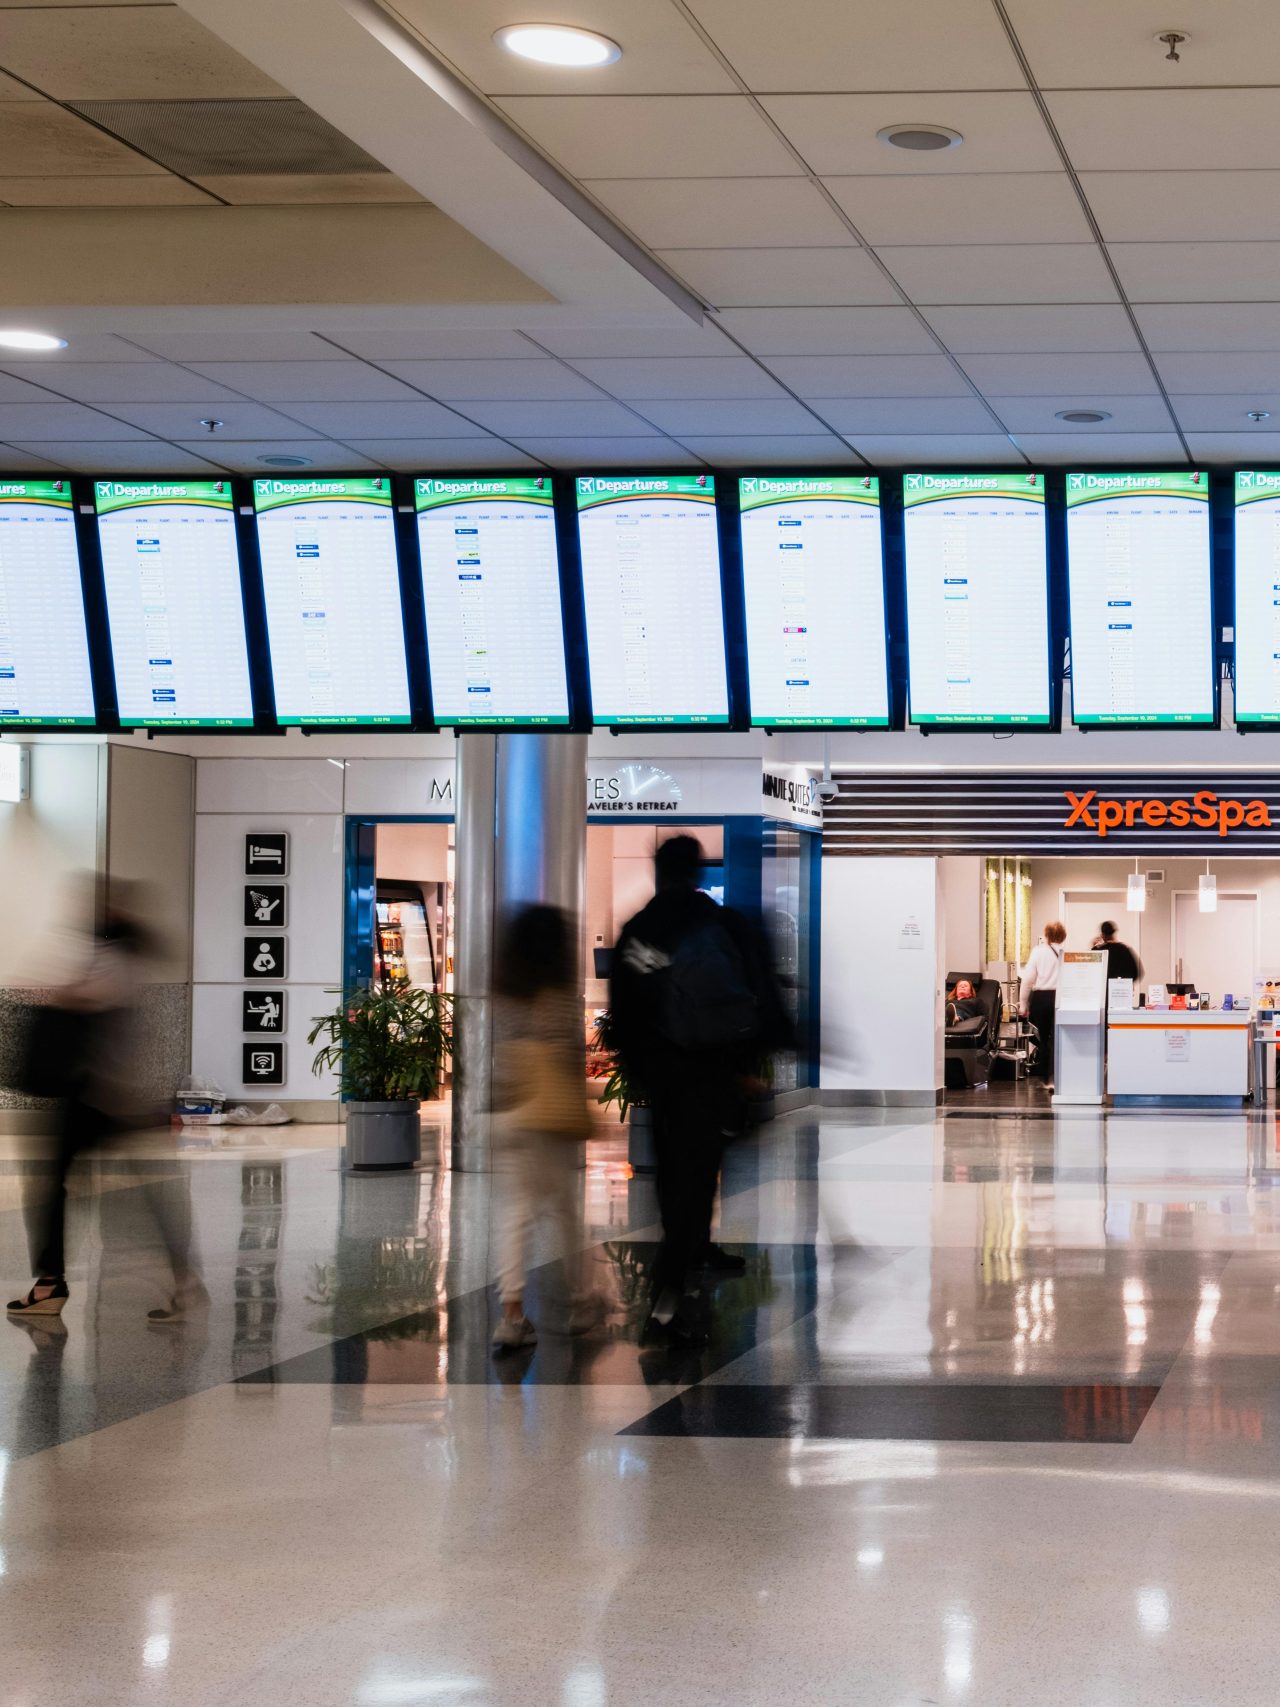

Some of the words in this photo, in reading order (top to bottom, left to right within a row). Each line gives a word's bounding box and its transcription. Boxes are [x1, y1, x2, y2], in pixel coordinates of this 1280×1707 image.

[273, 481, 346, 497] Departures
[434, 481, 507, 496] Departures
[596, 479, 669, 494] Departures
[760, 480, 833, 495] Departures
[923, 476, 998, 491] Departures
[1087, 475, 1161, 490] Departures
[114, 484, 187, 499] Departures
[588, 801, 633, 811] AVELER'S
[636, 801, 678, 811] RETREAT
[1064, 790, 1272, 836] XpresSpa
